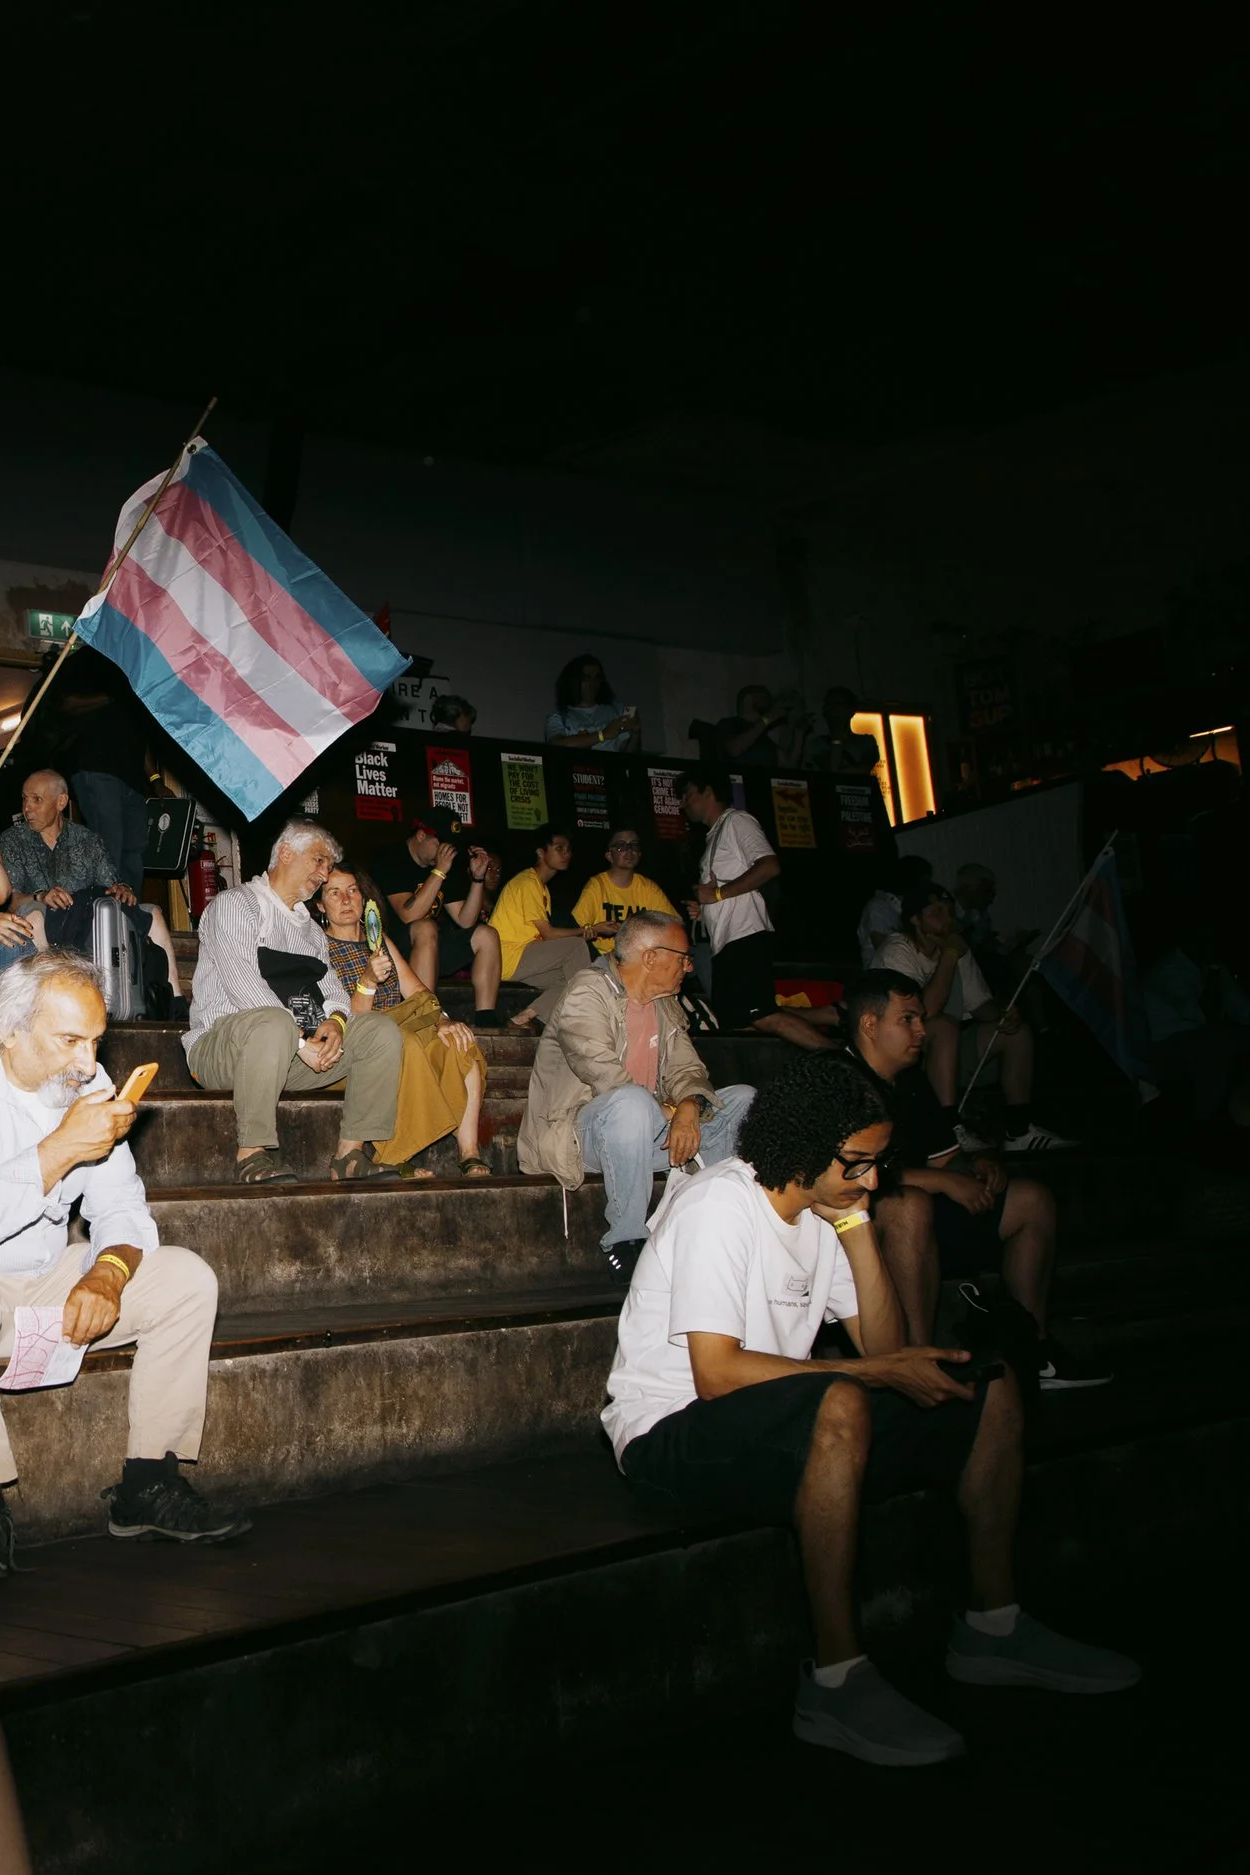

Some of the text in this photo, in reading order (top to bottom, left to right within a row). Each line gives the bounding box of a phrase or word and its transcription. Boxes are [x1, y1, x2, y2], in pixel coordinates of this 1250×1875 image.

[354, 751, 389, 768] Black
[354, 764, 387, 782] Lives
[572, 772, 605, 786] STUDENT?
[356, 779, 398, 798] Matter
[509, 779, 540, 789] THE COST
[434, 791, 467, 803] HOMES FOR
[509, 787, 540, 796] OF LIVING
[510, 795, 531, 804] CRISIS
[457, 803, 469, 812] NOT
[653, 804, 681, 816] GENOCIDE
[602, 902, 647, 923] TEA
